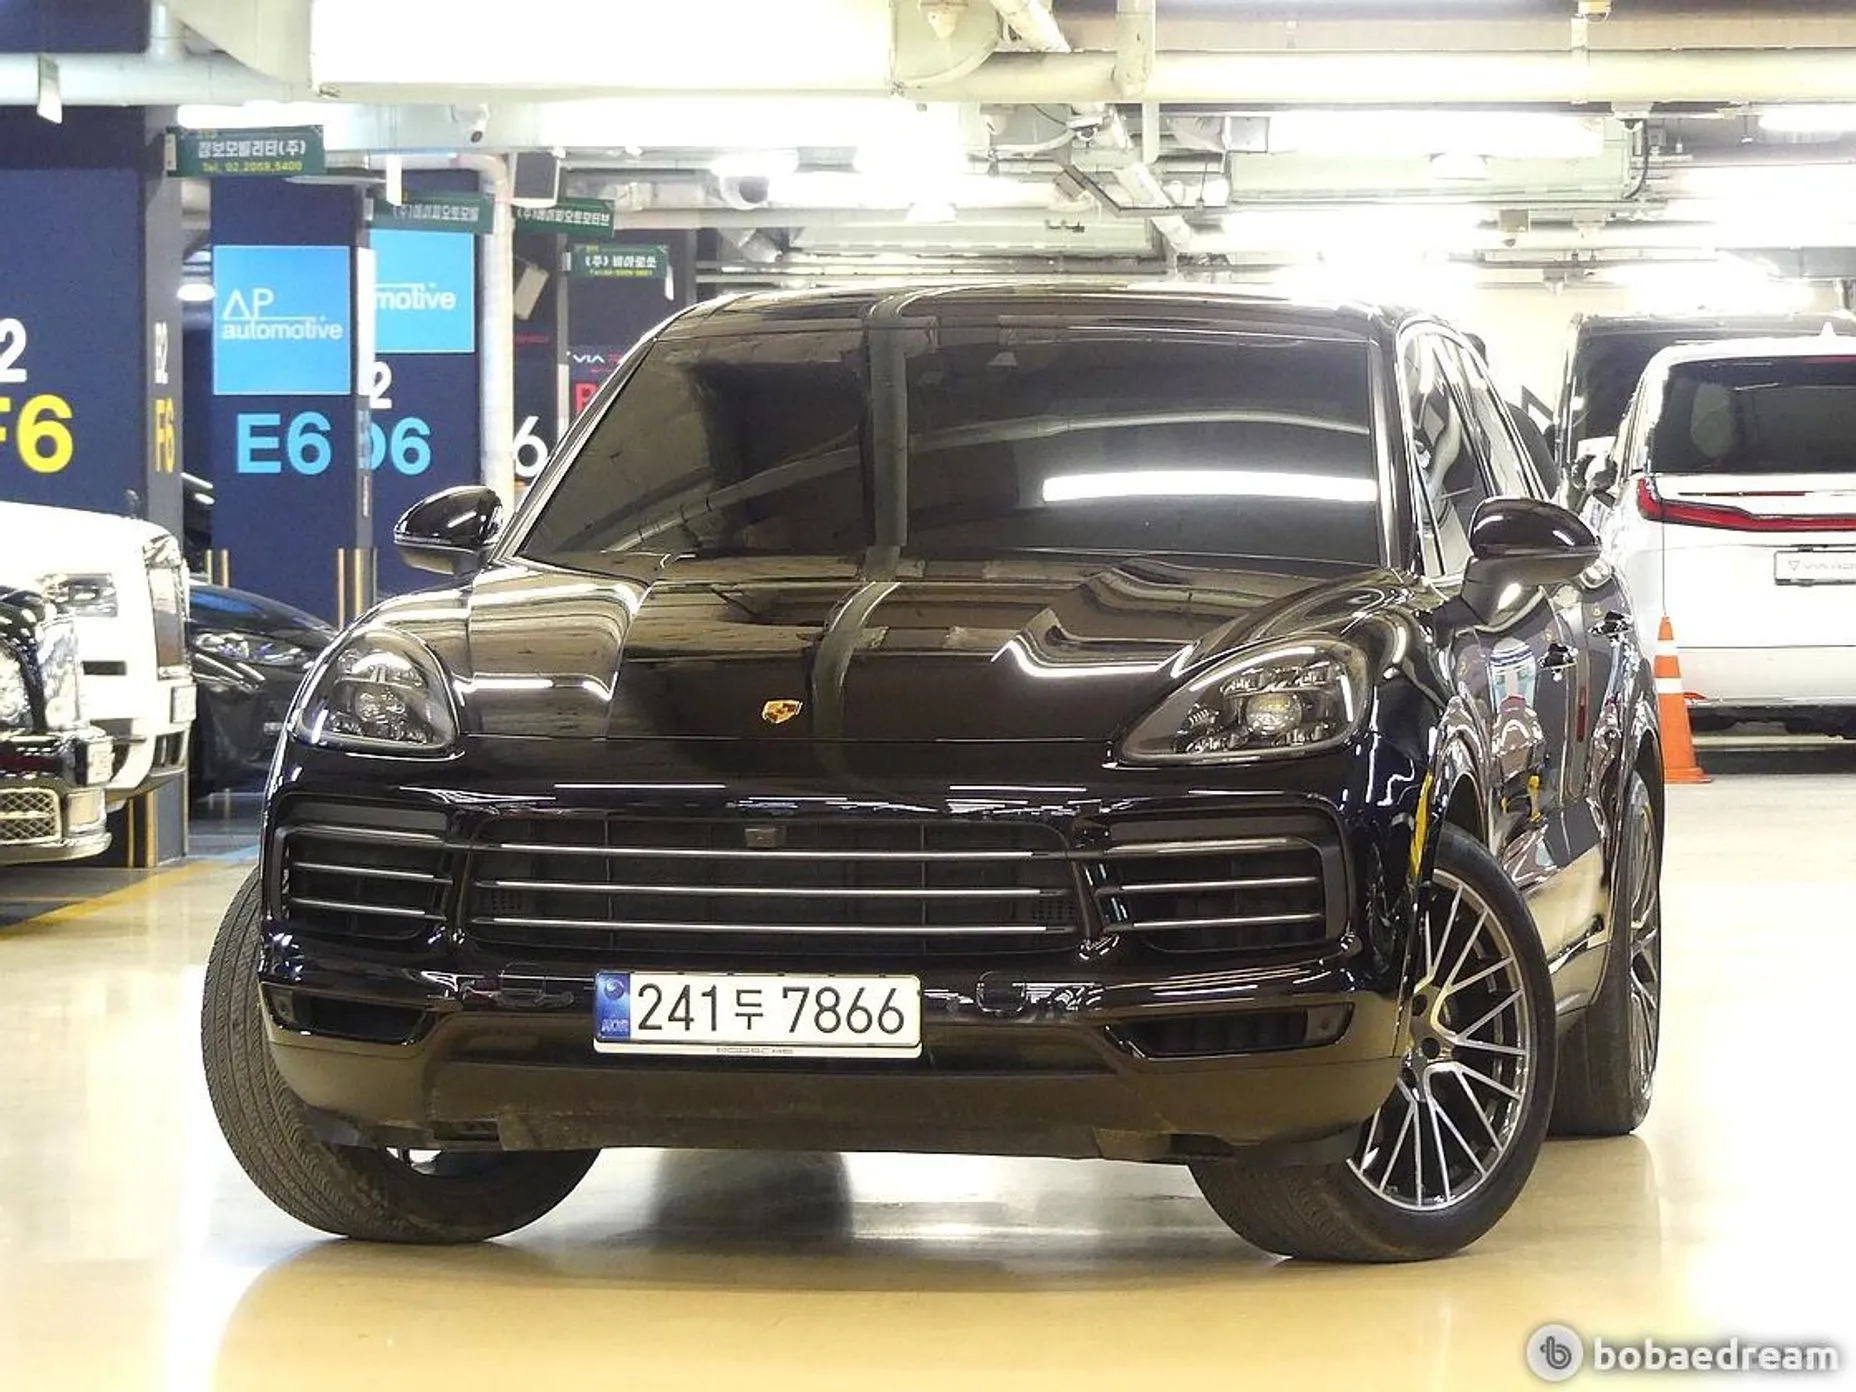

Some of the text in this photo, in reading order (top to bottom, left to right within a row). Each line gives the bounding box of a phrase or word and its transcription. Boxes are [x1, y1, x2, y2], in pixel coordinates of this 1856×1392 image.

[221, 317, 344, 340] automotive
[0, 394, 74, 474] 6
[155, 398, 175, 473] F6
[237, 411, 332, 475] E6
[782, 985, 905, 1034] 7866
